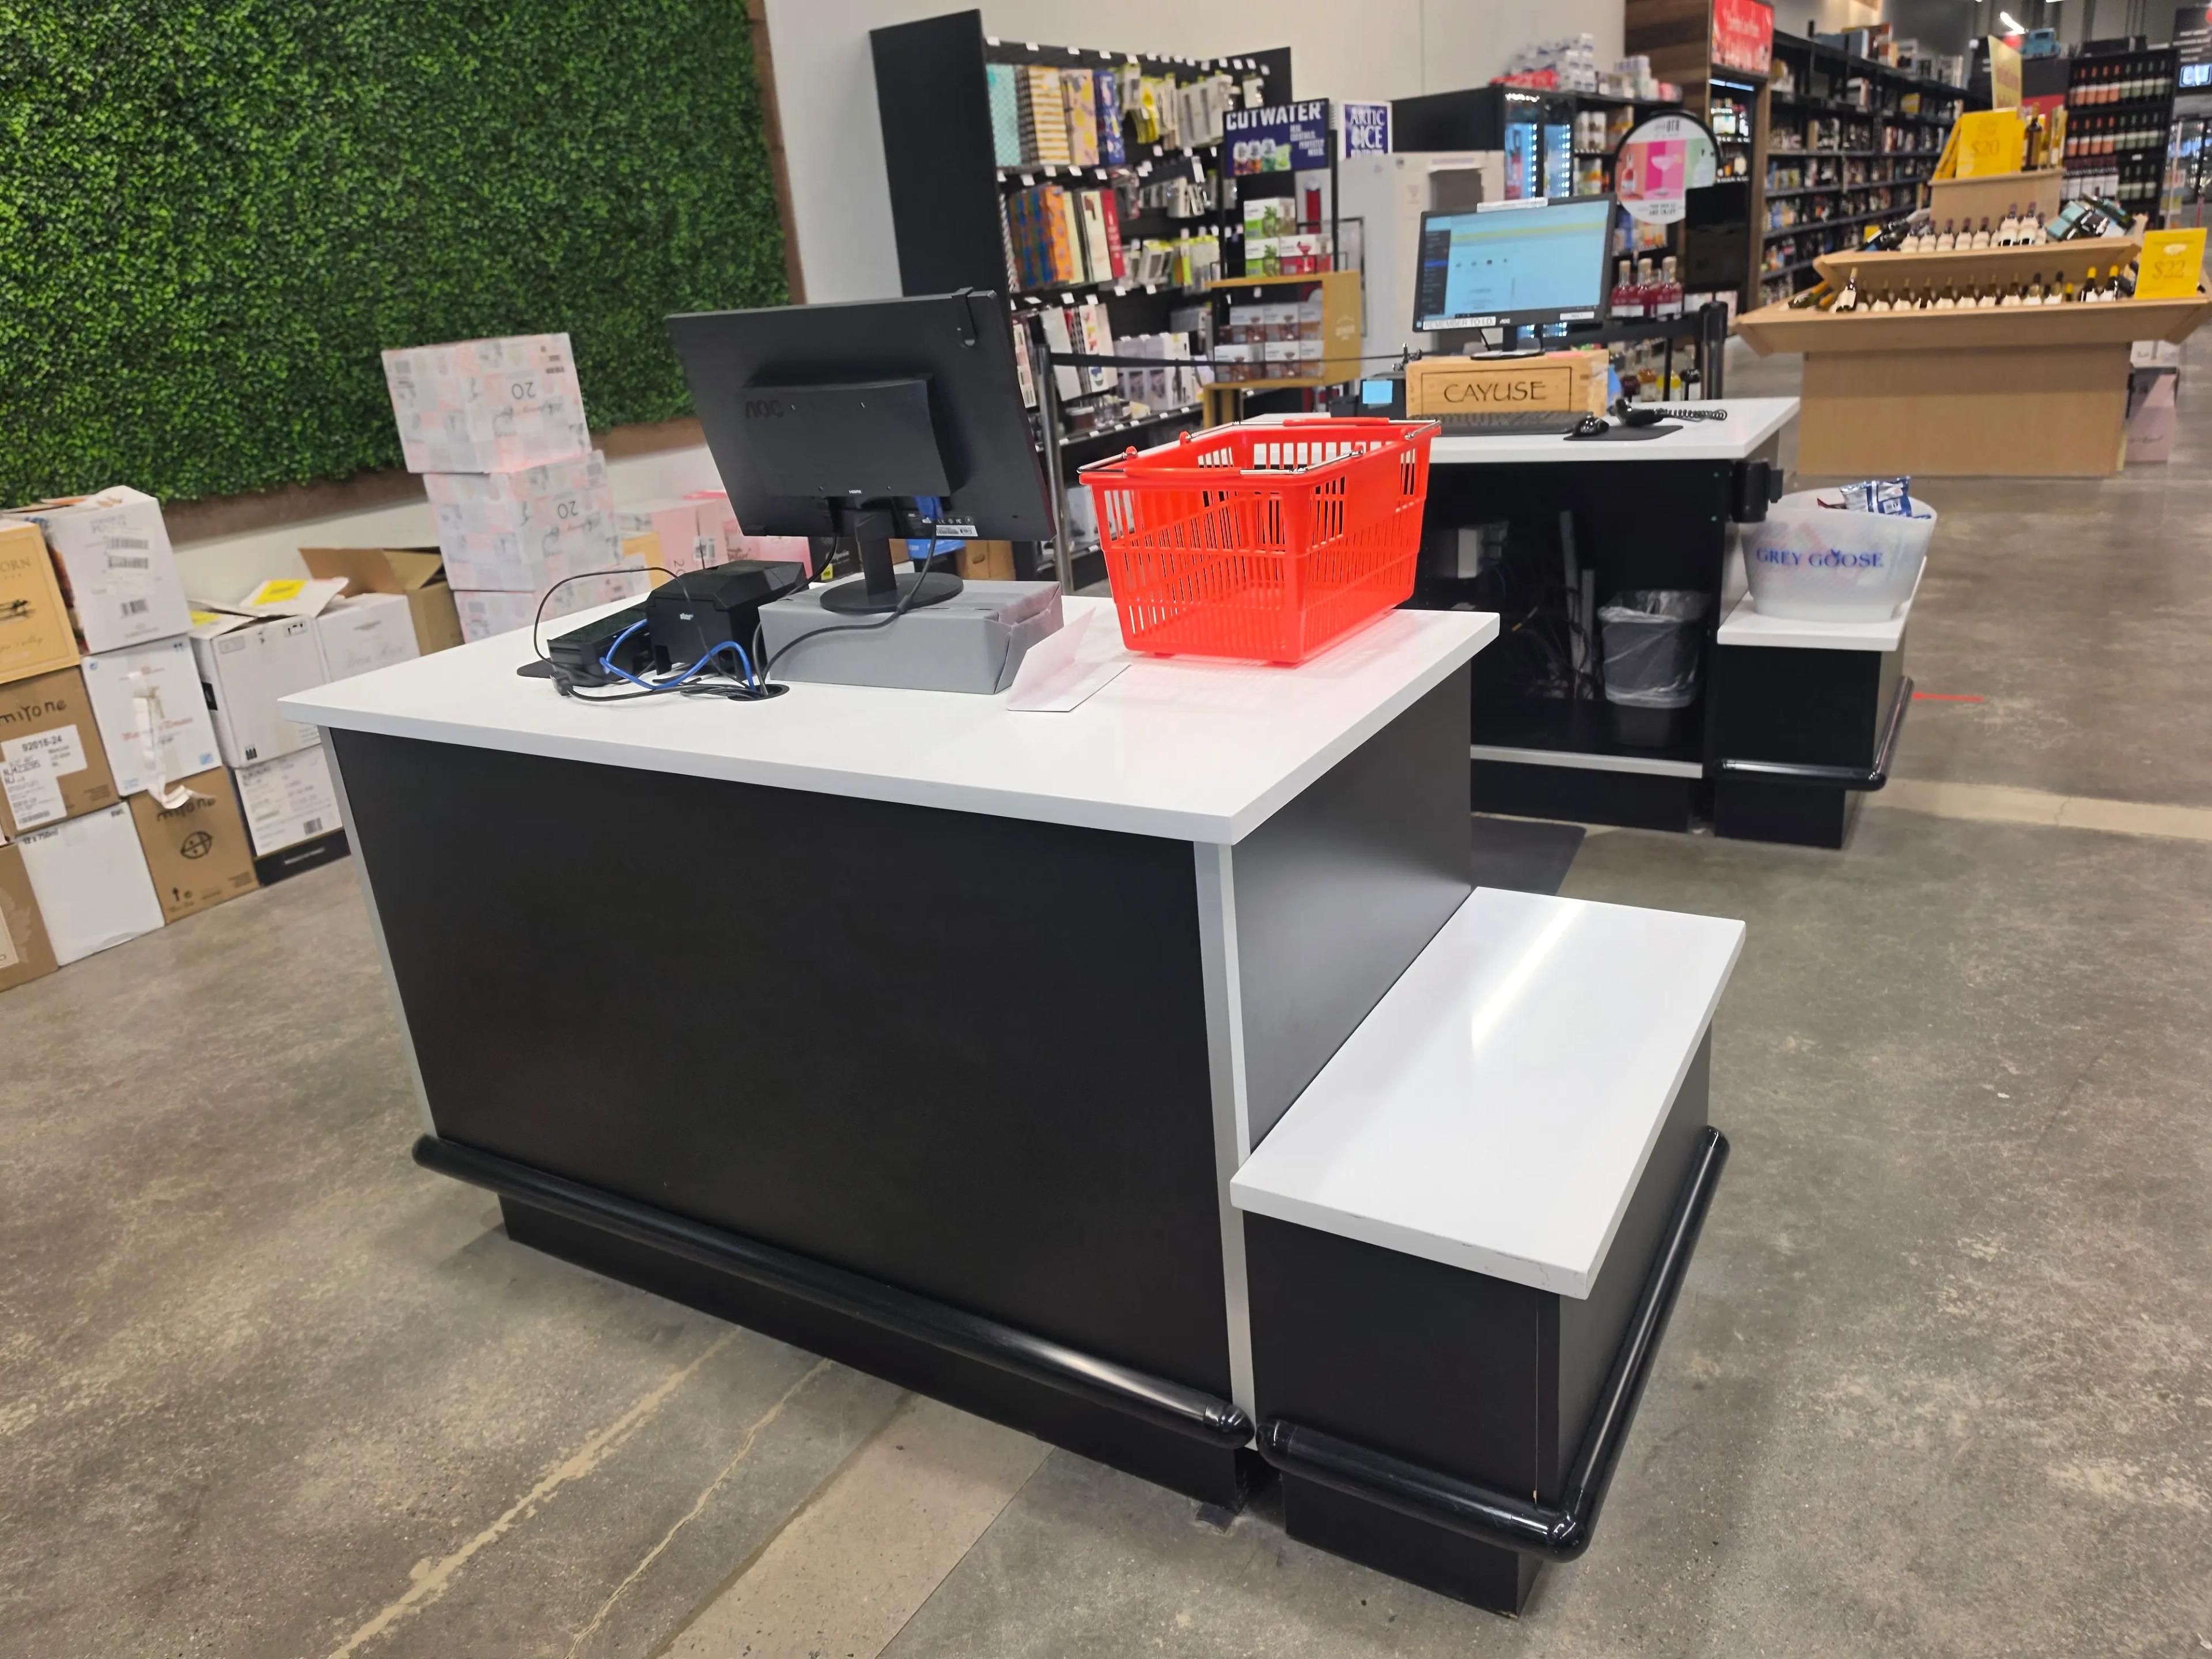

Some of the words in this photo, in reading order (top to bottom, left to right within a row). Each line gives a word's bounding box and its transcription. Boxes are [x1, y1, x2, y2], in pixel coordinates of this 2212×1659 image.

[1226, 101, 1321, 131] CUTWATER
[1360, 126, 1383, 148] ICE
[2152, 260, 2186, 279] $22
[1444, 381, 1546, 403] CAYUSE
[1757, 549, 1800, 566] GREY
[1808, 550, 1884, 567] GOOSE
